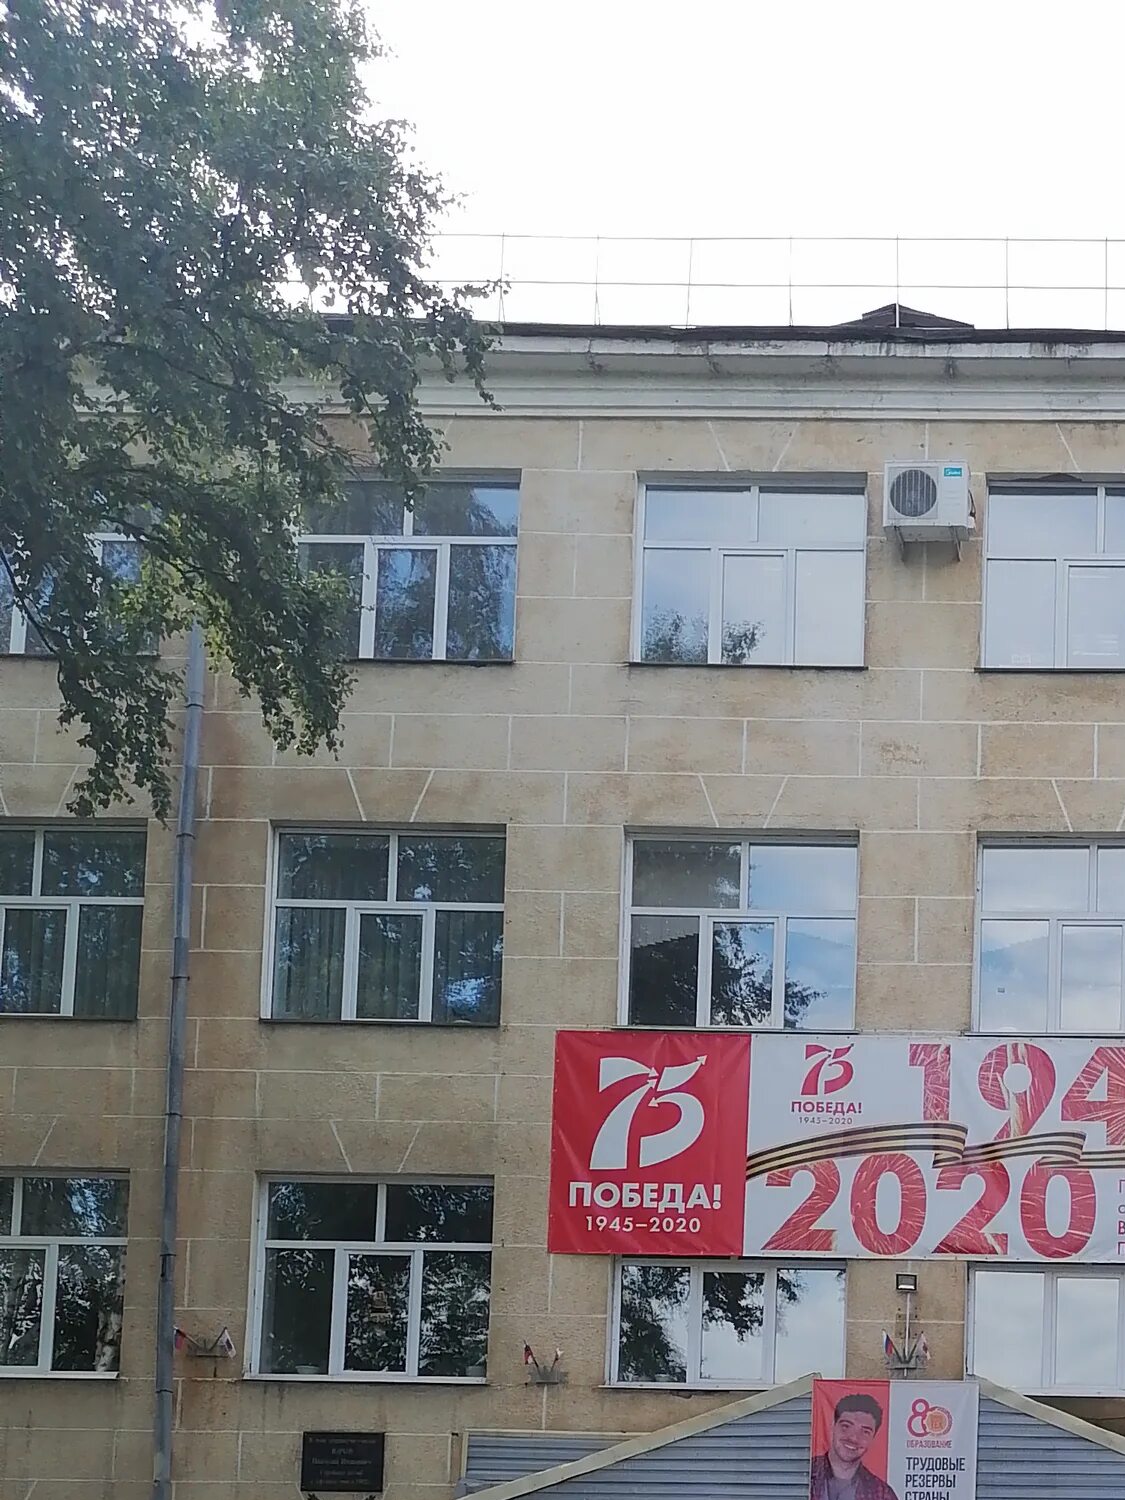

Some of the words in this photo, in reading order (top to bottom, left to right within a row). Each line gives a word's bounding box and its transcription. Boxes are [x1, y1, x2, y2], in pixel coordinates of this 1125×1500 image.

[800, 1043, 855, 1096] 75
[590, 1055, 707, 1171] 75
[791, 1101, 863, 1115] ПОБЕДА!
[568, 1181, 722, 1214] ПОБЕДА!
[760, 1153, 1097, 1259] 2020
[1117, 1204, 1125, 1215] с
[906, 1439, 953, 1449] ОБРАЗОВАНИЕ
[905, 1456, 966, 1472] ТРУДОВЫЕ
[904, 1474, 957, 1489] РЕЗЕРВЫ
